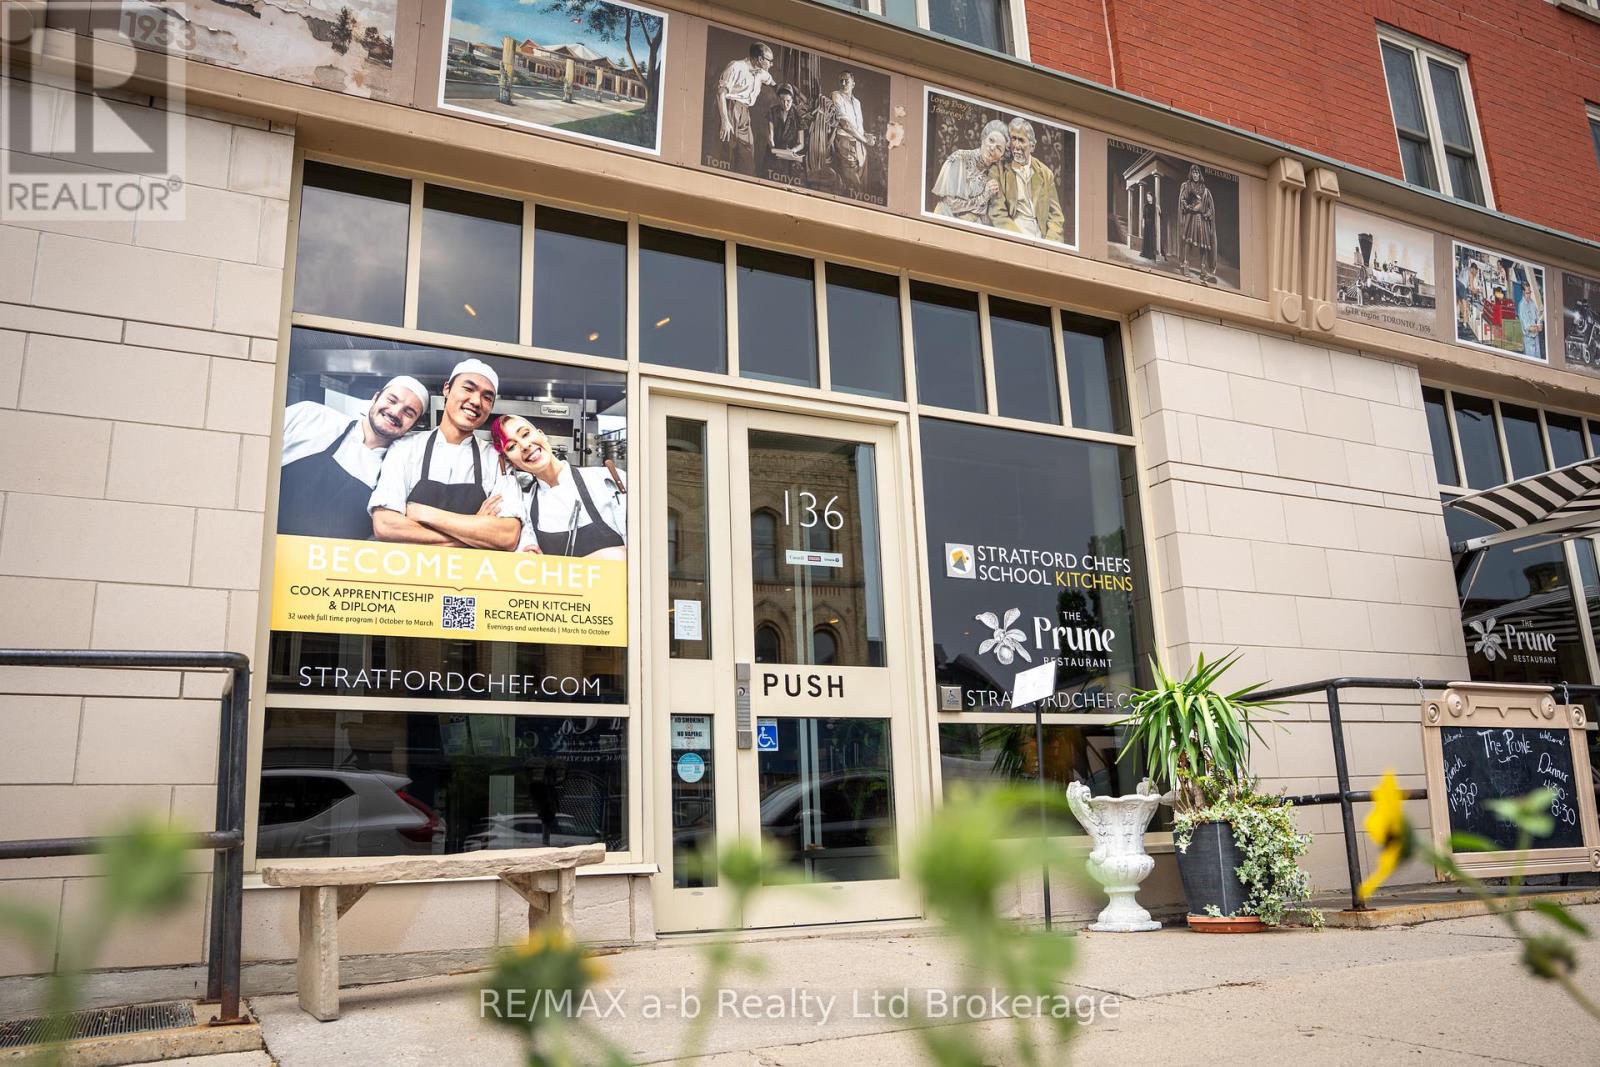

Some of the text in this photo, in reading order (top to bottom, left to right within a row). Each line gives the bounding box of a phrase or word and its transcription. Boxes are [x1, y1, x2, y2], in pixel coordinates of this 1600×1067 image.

[124, 11, 197, 51] 1953
[706, 154, 731, 170] Tom
[767, 169, 801, 186] Tanya
[849, 187, 884, 204] Tyrone
[1361, 311, 1380, 321] engine
[784, 490, 844, 530] 136
[306, 543, 602, 589] BECOME A CHEF
[977, 545, 1131, 574] STRATFORD CHEFS
[978, 565, 1134, 592] SCHOOL KITCHENS
[290, 585, 435, 603] COOK APPRENTICESHIP
[328, 600, 396, 613] & DIPLOMA
[508, 598, 591, 612] OPEN KITCHEN
[1062, 611, 1081, 620] THE
[288, 612, 296, 620] 32
[297, 612, 315, 620] week
[316, 613, 328, 622] full
[345, 617, 373, 625] program
[414, 619, 434, 627] March
[484, 609, 614, 626] RECREATIONAL CLASSES
[1521, 619, 1535, 627] THE
[486, 623, 514, 632] Evenings
[528, 625, 557, 633] weekends
[588, 628, 611, 636] October
[1033, 616, 1116, 652] Prune
[1504, 623, 1557, 652] Prune
[1513, 654, 1557, 664] RESTAURANT
[299, 666, 601, 698] STRATFORDCHEF.COM
[763, 673, 845, 698] PUSH
[1477, 729, 1503, 758] The
[1444, 754, 1467, 793] Lunch
[1537, 752, 1569, 783] Dinner
[1551, 799, 1576, 826] 8:30
